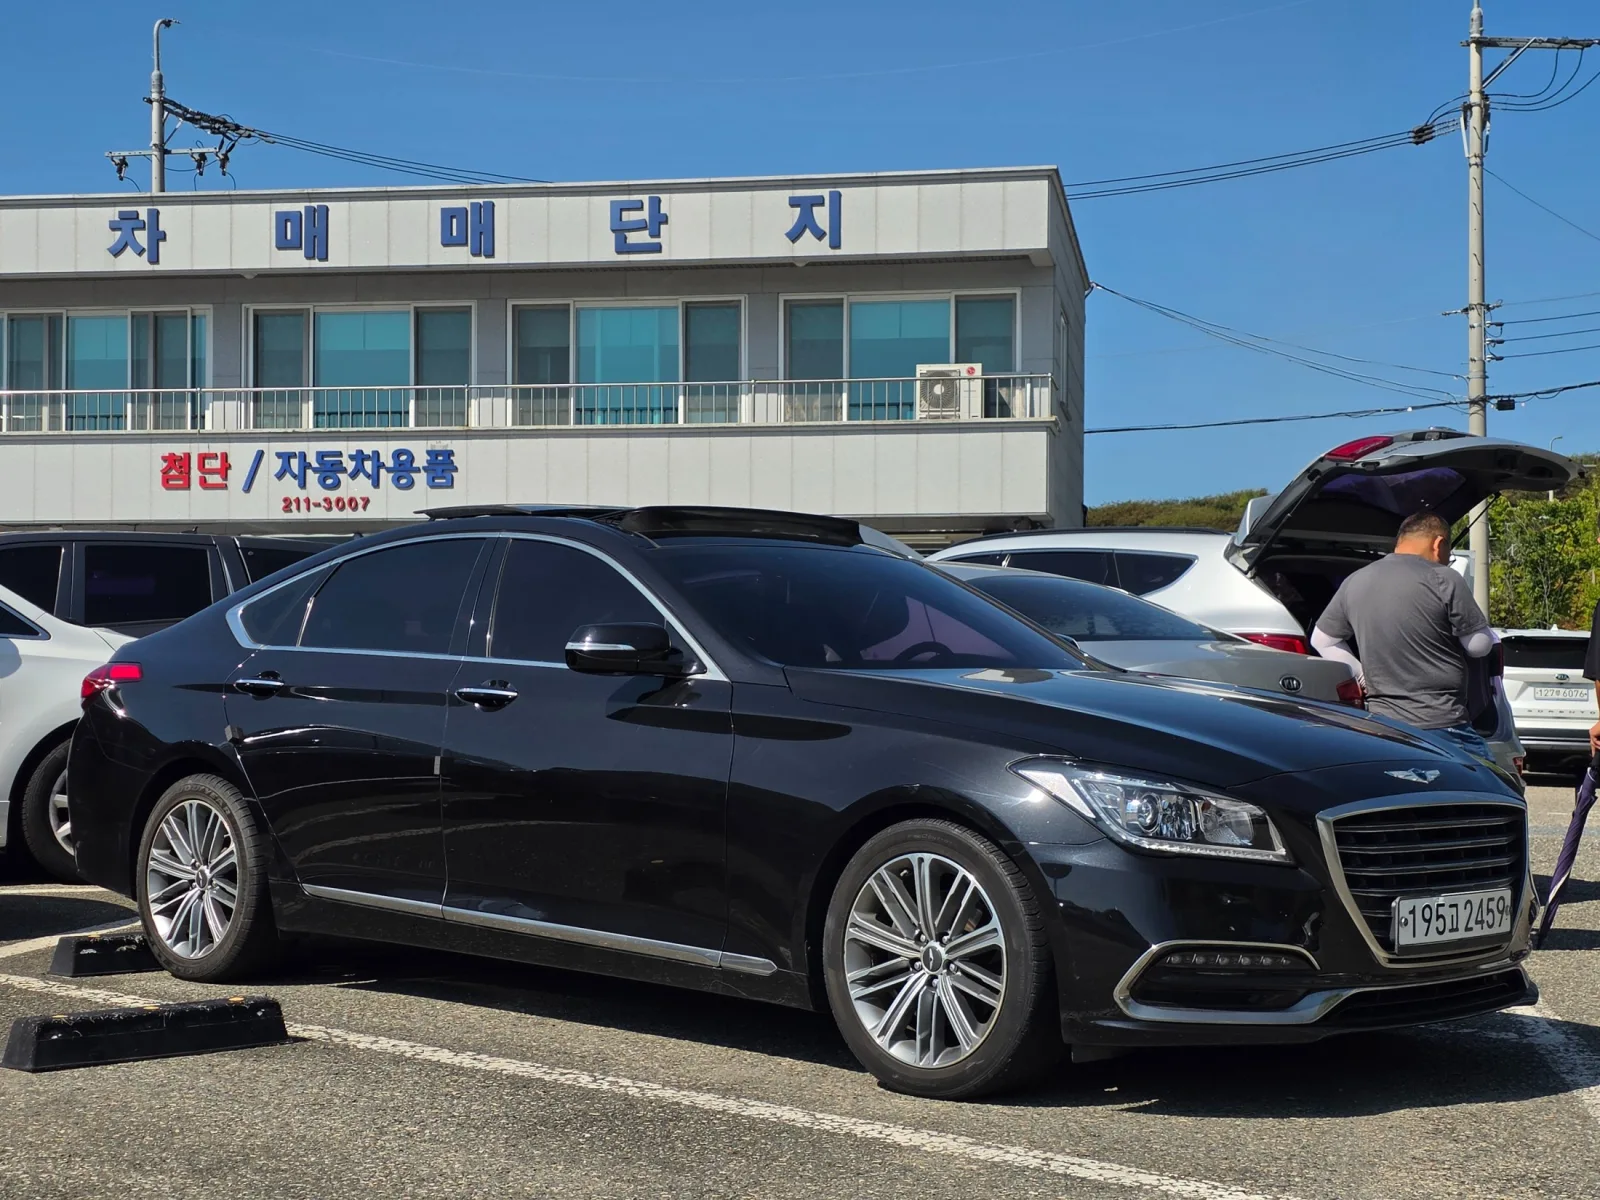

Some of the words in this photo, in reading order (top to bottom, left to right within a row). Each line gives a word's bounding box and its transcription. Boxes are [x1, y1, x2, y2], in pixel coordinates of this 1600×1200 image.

[160, 452, 232, 491] 첨단
[242, 449, 265, 494] /
[274, 448, 458, 490] 자동차용품
[282, 496, 370, 513] 211-3007
[1463, 895, 1506, 933] 2459
